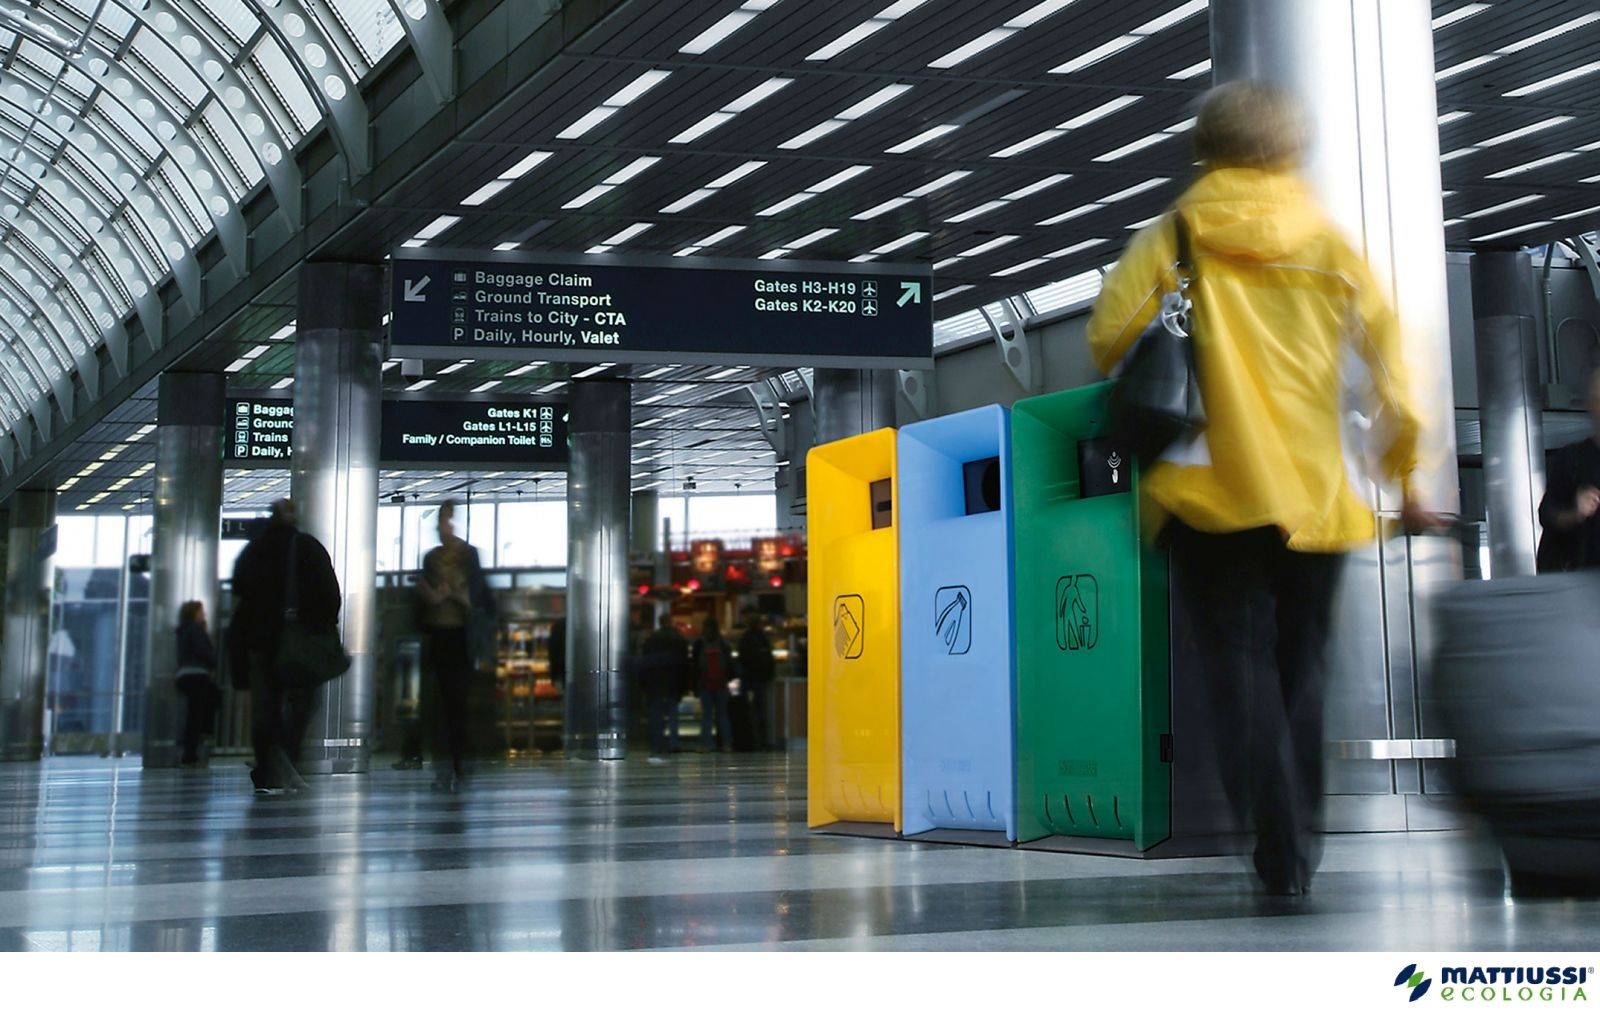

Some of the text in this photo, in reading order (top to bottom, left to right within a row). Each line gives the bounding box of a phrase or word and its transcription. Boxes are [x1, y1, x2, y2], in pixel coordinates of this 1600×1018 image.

[475, 271, 592, 287] Baggage Claim
[754, 279, 857, 295] Gates H3-H19
[475, 290, 612, 308] Ground Transport
[754, 297, 857, 314] Gates K2-K20
[475, 309, 522, 323] Trains
[527, 311, 543, 324] to
[548, 310, 579, 327] City
[594, 312, 627, 326] CTA
[474, 328, 516, 344] Daily,
[522, 329, 576, 346] Hourly,
[581, 331, 620, 345] Valet
[487, 407, 537, 419] Gates K1
[462, 420, 537, 432] Gates L1-L15
[252, 432, 289, 442] Trains
[402, 433, 536, 446] Family / Companion Toilet
[252, 446, 284, 458] Daily,
